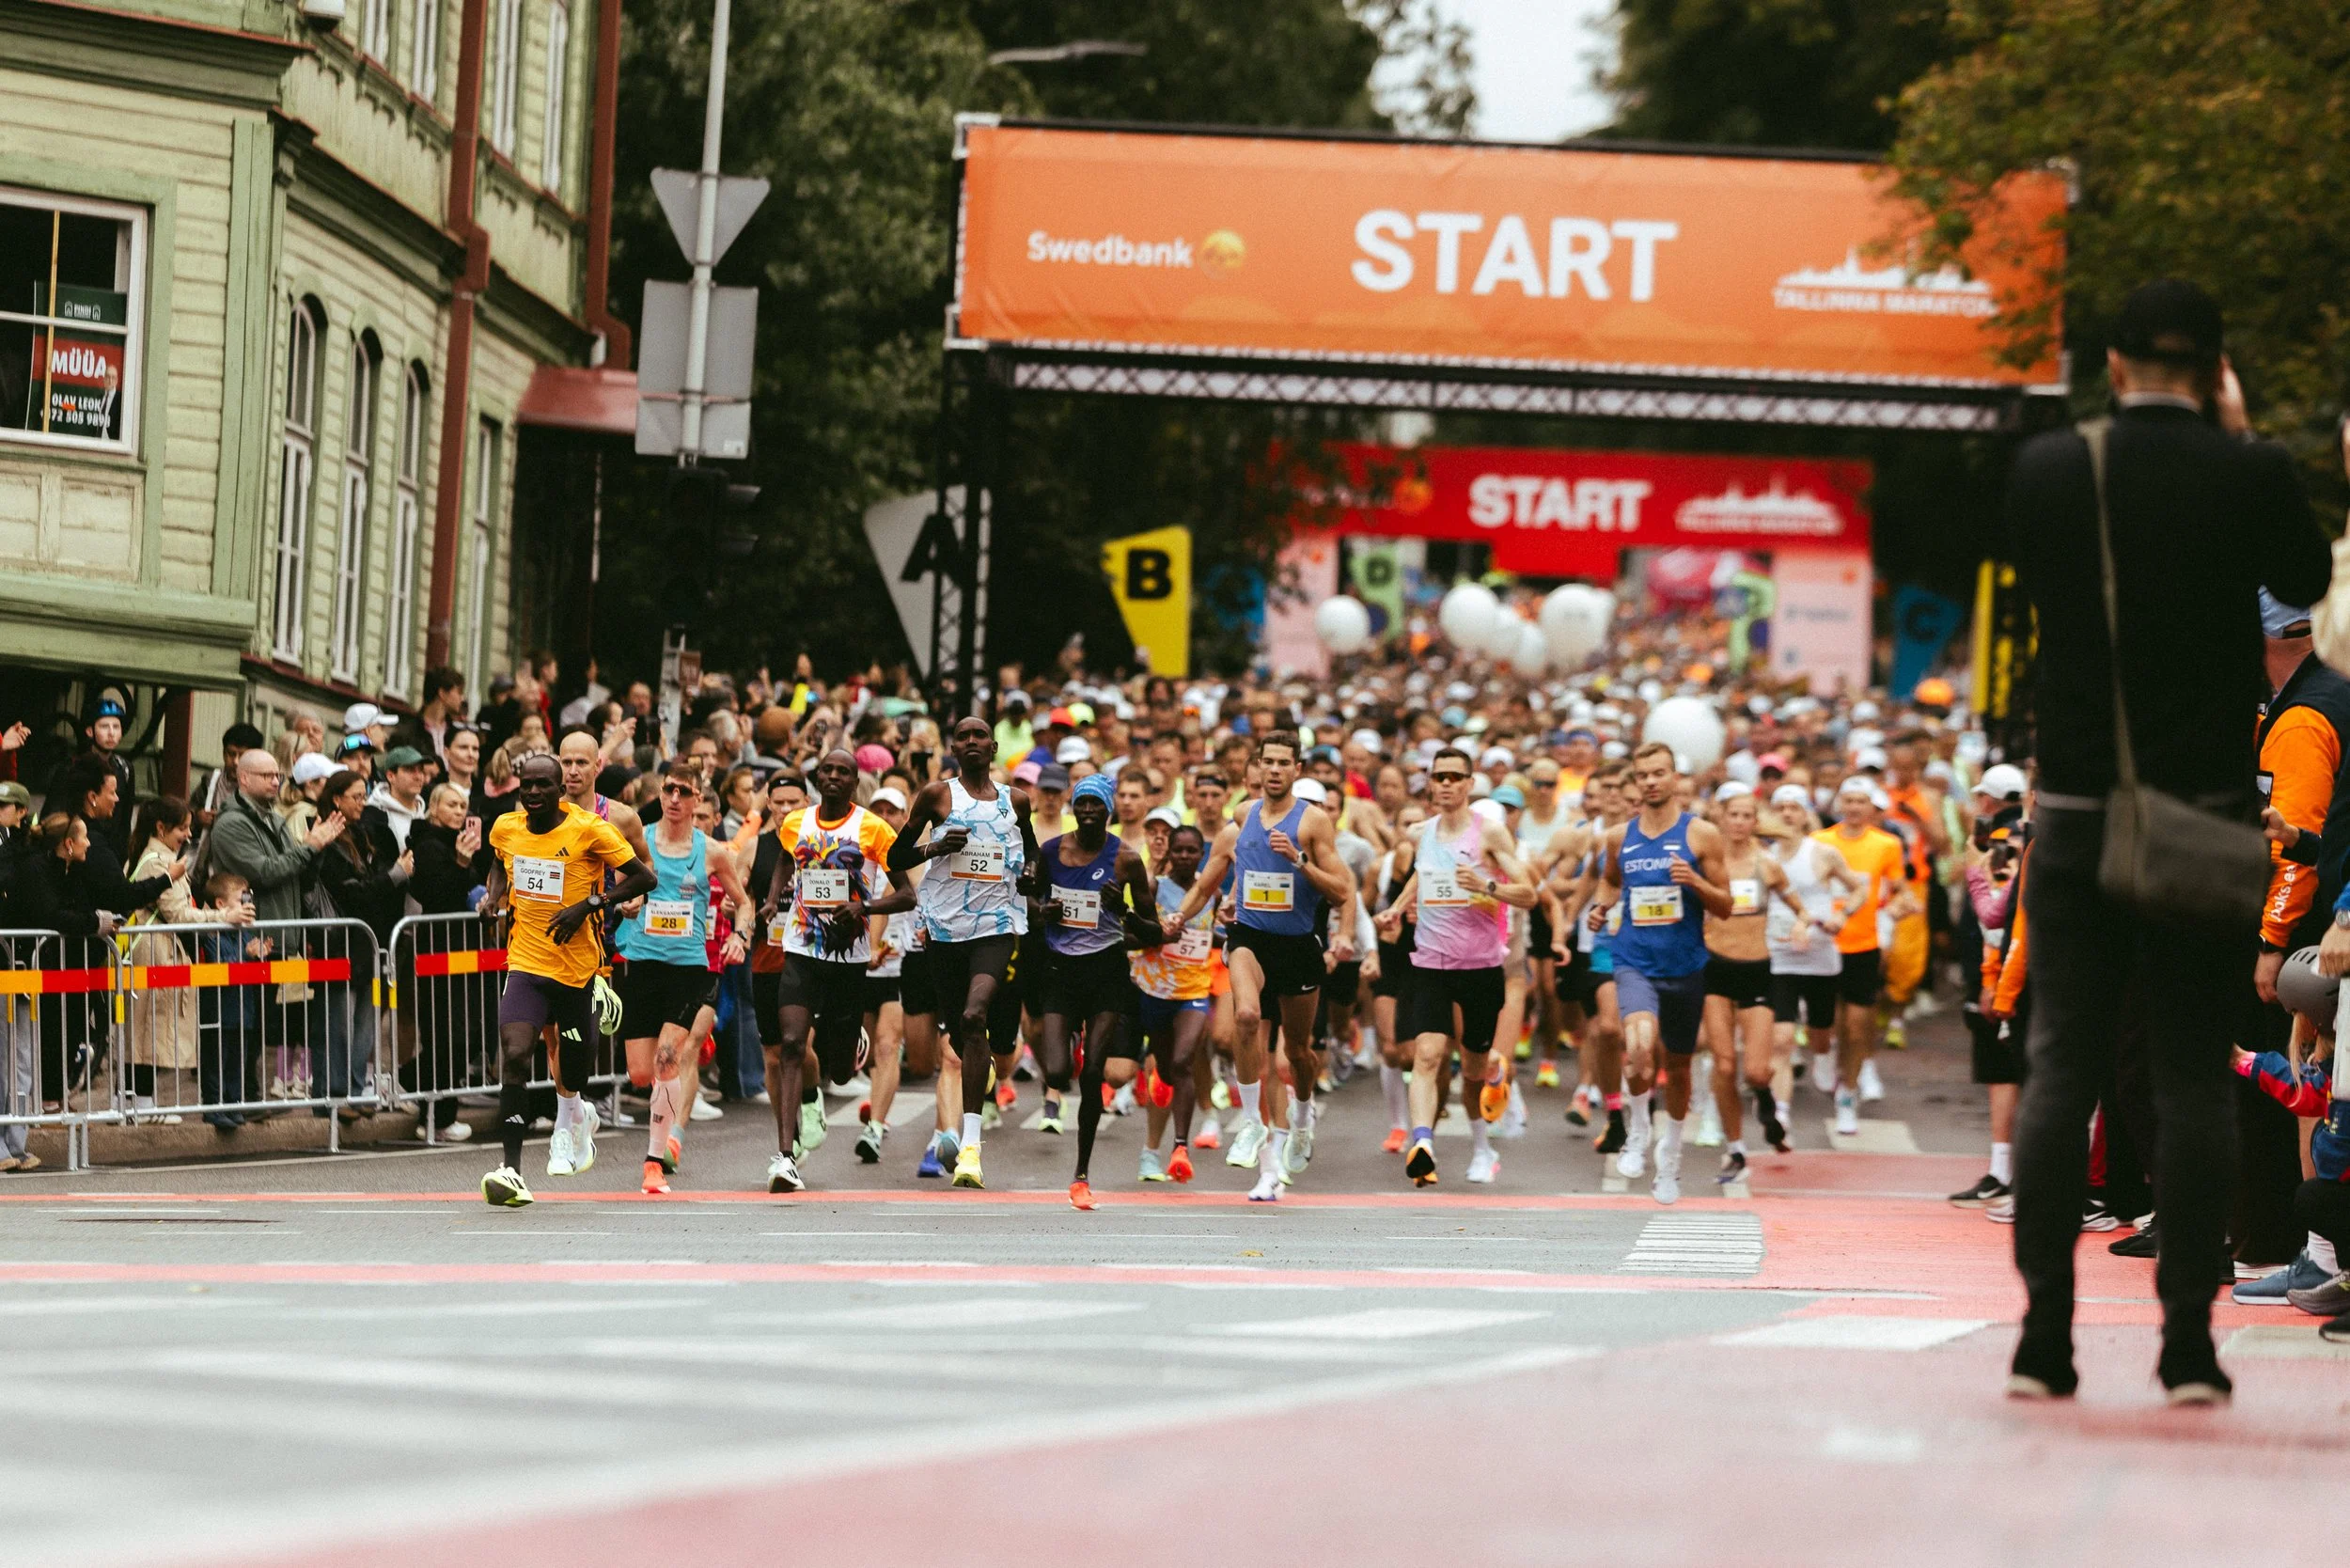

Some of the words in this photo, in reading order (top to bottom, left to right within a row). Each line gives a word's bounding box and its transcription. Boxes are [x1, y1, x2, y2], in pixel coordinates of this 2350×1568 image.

[1027, 231, 1192, 267] Swedbank
[1351, 209, 1679, 302] START
[52, 347, 106, 379] MÜÜA
[1467, 474, 1653, 532] START
[901, 511, 963, 582] A
[1128, 548, 1172, 600] B
[970, 859, 988, 872] 52
[527, 877, 543, 890] 54
[815, 886, 831, 898] 53
[1263, 890, 1269, 902] 1
[1436, 886, 1452, 898] 55
[1063, 906, 1078, 918] 51
[1648, 905, 1663, 916] 18
[662, 917, 677, 929] 28
[1180, 944, 1195, 955] 57
